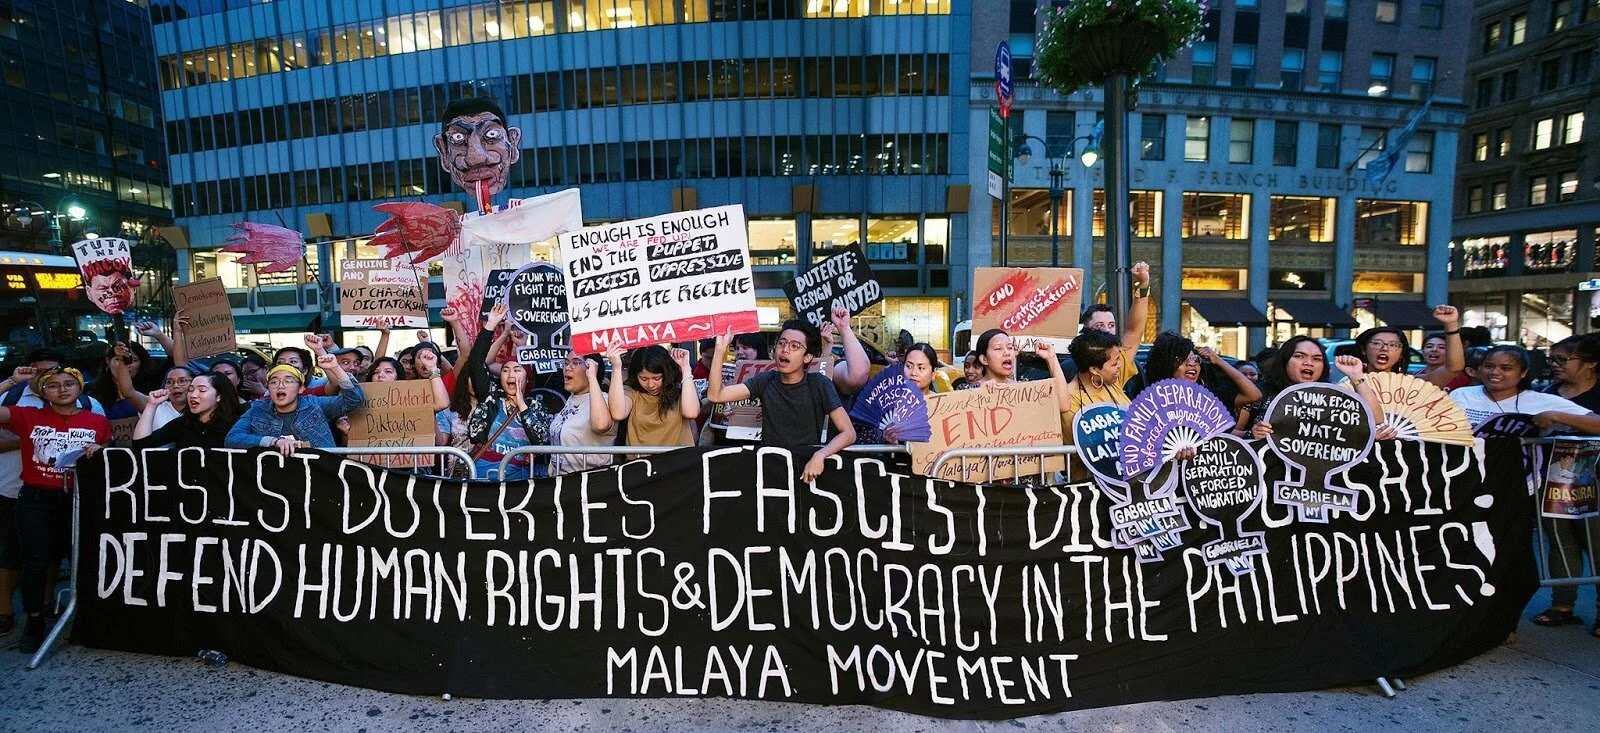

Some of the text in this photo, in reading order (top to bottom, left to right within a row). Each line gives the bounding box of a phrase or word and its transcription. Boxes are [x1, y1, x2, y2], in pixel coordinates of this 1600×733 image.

[1033, 166, 1072, 181] TE
[1196, 171, 1279, 188] FRENCH
[571, 211, 729, 249] ENOUGH IS ENOUGH
[77, 239, 128, 256] TUTA
[96, 249, 114, 257] NI
[592, 232, 692, 254] WE ARE FED UP!
[342, 259, 389, 270] GENUINE
[569, 254, 603, 278] END
[606, 248, 637, 266] THE
[650, 252, 743, 281] OPPRESSIVE
[794, 250, 858, 293] DUTERTE:
[342, 272, 365, 281] AND
[518, 272, 544, 283] JUNK
[341, 287, 367, 299] NOT
[369, 287, 416, 299] CHA-CHA
[514, 284, 543, 296] FIGHT
[547, 285, 566, 296] FOR
[571, 277, 751, 323] US-DUTERTE REGIME
[794, 271, 857, 313] RESIGN OR
[989, 283, 1015, 307] END
[352, 298, 429, 313] DICTATORSHIP
[531, 297, 562, 309] NAT'L
[806, 279, 880, 328] BE OUSTED
[1018, 275, 1079, 331] ualization!
[591, 322, 676, 350] MALAYA
[539, 361, 551, 370] NY
[865, 375, 895, 405] WOMEN
[878, 388, 920, 409] FASCIST
[1292, 390, 1328, 407] JUNK
[928, 392, 975, 420] Junk
[974, 392, 992, 409] the
[1284, 404, 1361, 426] FIGHT FOR
[1412, 394, 1459, 433] Ako
[33, 426, 54, 437] STOP
[70, 430, 95, 440] KILLINGS
[366, 412, 421, 434] Diktador
[941, 406, 1013, 447] END
[1079, 410, 1124, 435] BABAE
[1123, 383, 1228, 477] END FAMILY SEPARATION
[1298, 421, 1347, 442] NAT'L
[1493, 416, 1535, 438] LIFT
[1103, 426, 1122, 442] AK
[1202, 439, 1228, 452] END
[1279, 437, 1362, 462] SOVEREIGNTY
[1193, 449, 1240, 467] FAMILY
[1185, 464, 1253, 481] SEPARATION
[103, 447, 320, 533] RESIST
[702, 445, 987, 557] FASCIST
[1025, 438, 1496, 553] DICOSHIP!
[1190, 477, 1246, 496] & FORCED
[1196, 485, 1258, 510] MIGRATION!
[1279, 485, 1350, 506] GABRIELA
[1114, 498, 1172, 524] GABRIELA
[1305, 507, 1320, 518] NY
[1137, 517, 1156, 533] NY
[1138, 544, 1155, 557] NY
[1156, 533, 1172, 547] NY
[1206, 537, 1262, 559] GABRIELA
[1228, 555, 1248, 571] NY
[98, 521, 1496, 652] DEFEND HUMAN RIGHTS & DEMOCRACY IN THE PHILIPPINES!
[605, 644, 1079, 705] MALAYA MOVEMENT
